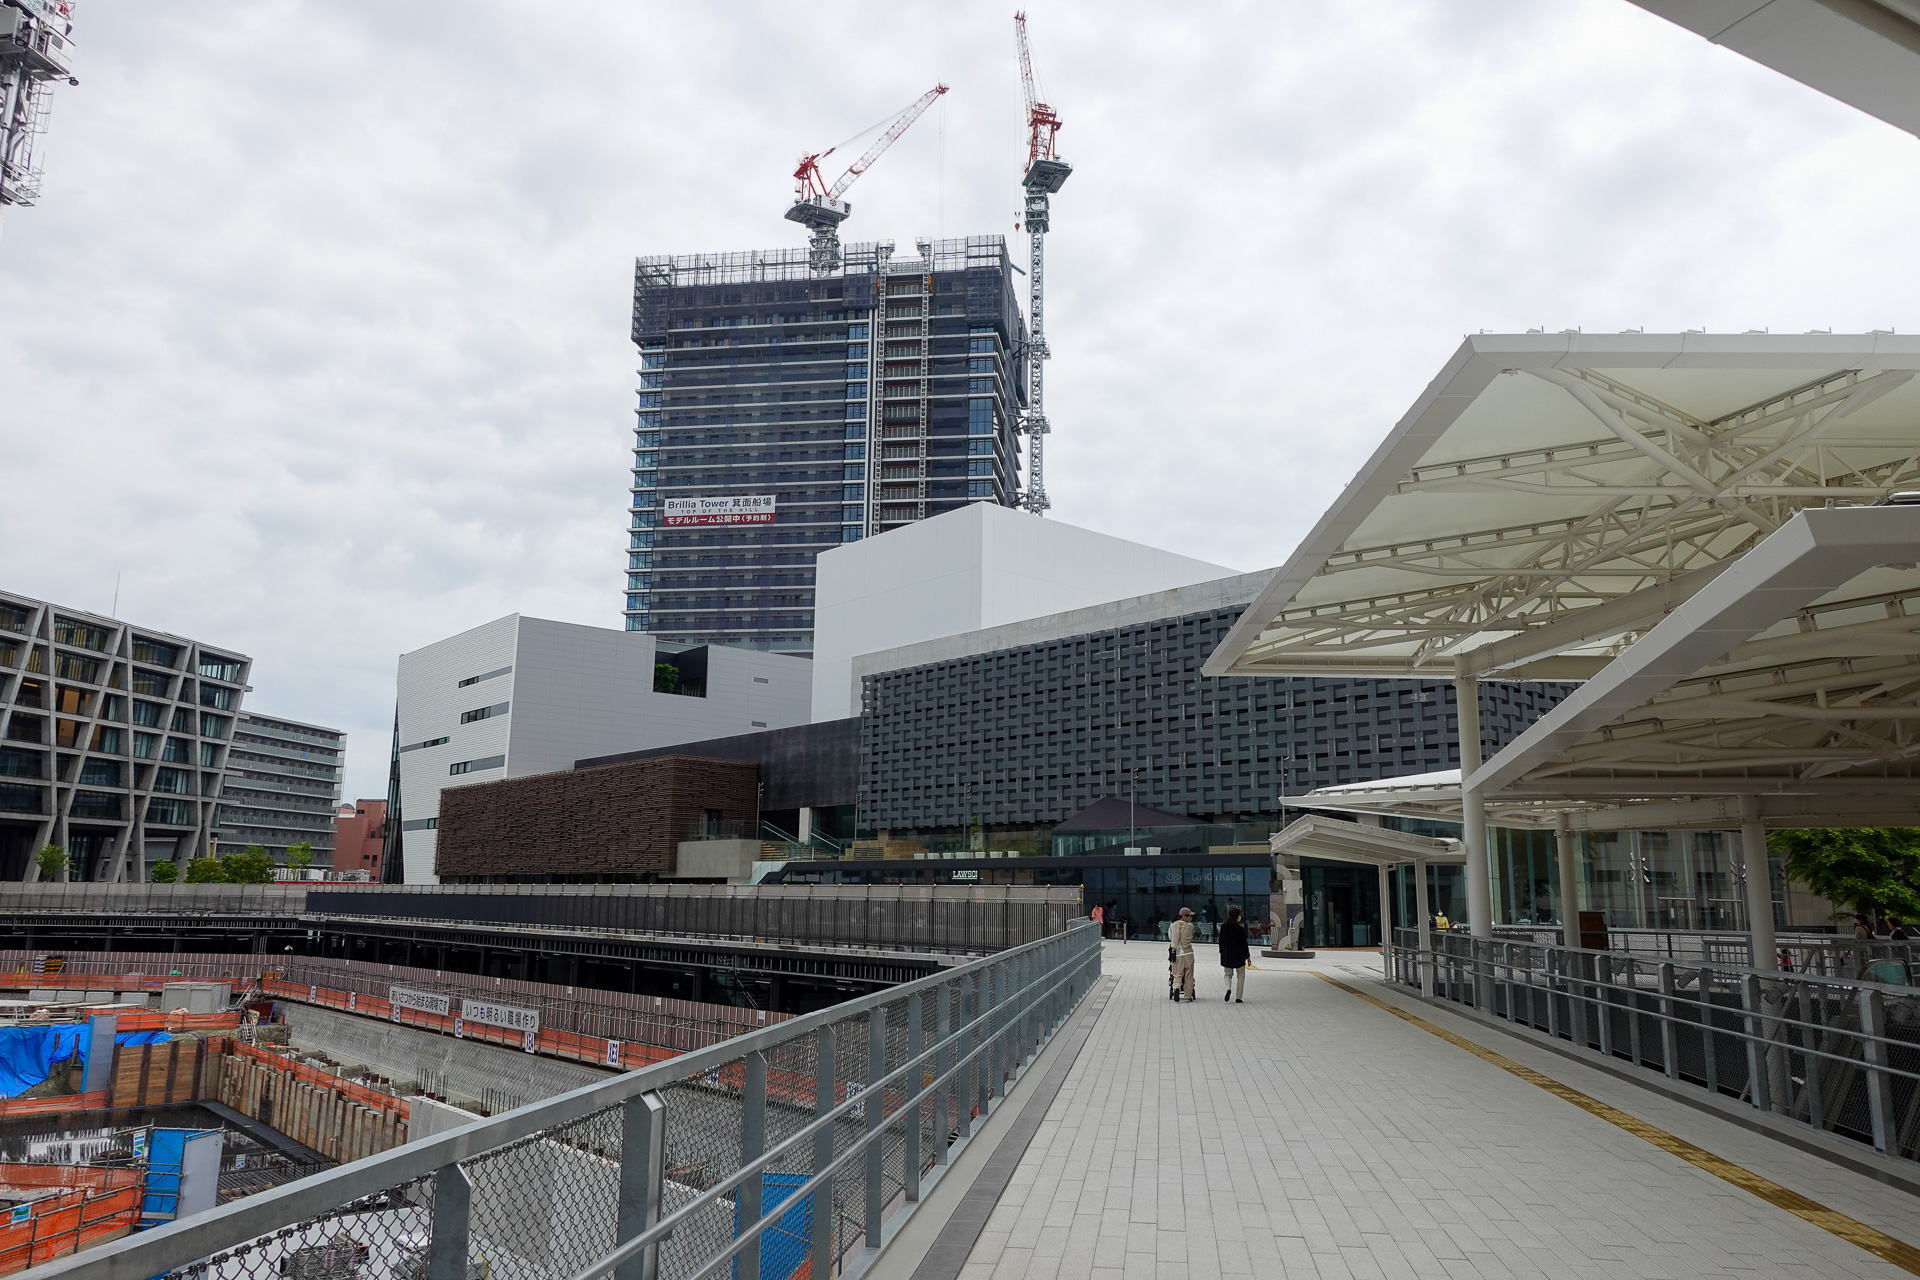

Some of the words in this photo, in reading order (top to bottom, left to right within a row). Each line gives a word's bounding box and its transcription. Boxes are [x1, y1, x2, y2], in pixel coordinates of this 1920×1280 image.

[668, 501, 696, 509] Brillia
[700, 499, 729, 508] Tower
[732, 497, 772, 507] 箕面船場
[952, 870, 978, 878] LAWSO
[465, 1003, 536, 1029] いつも明るい職場作り
